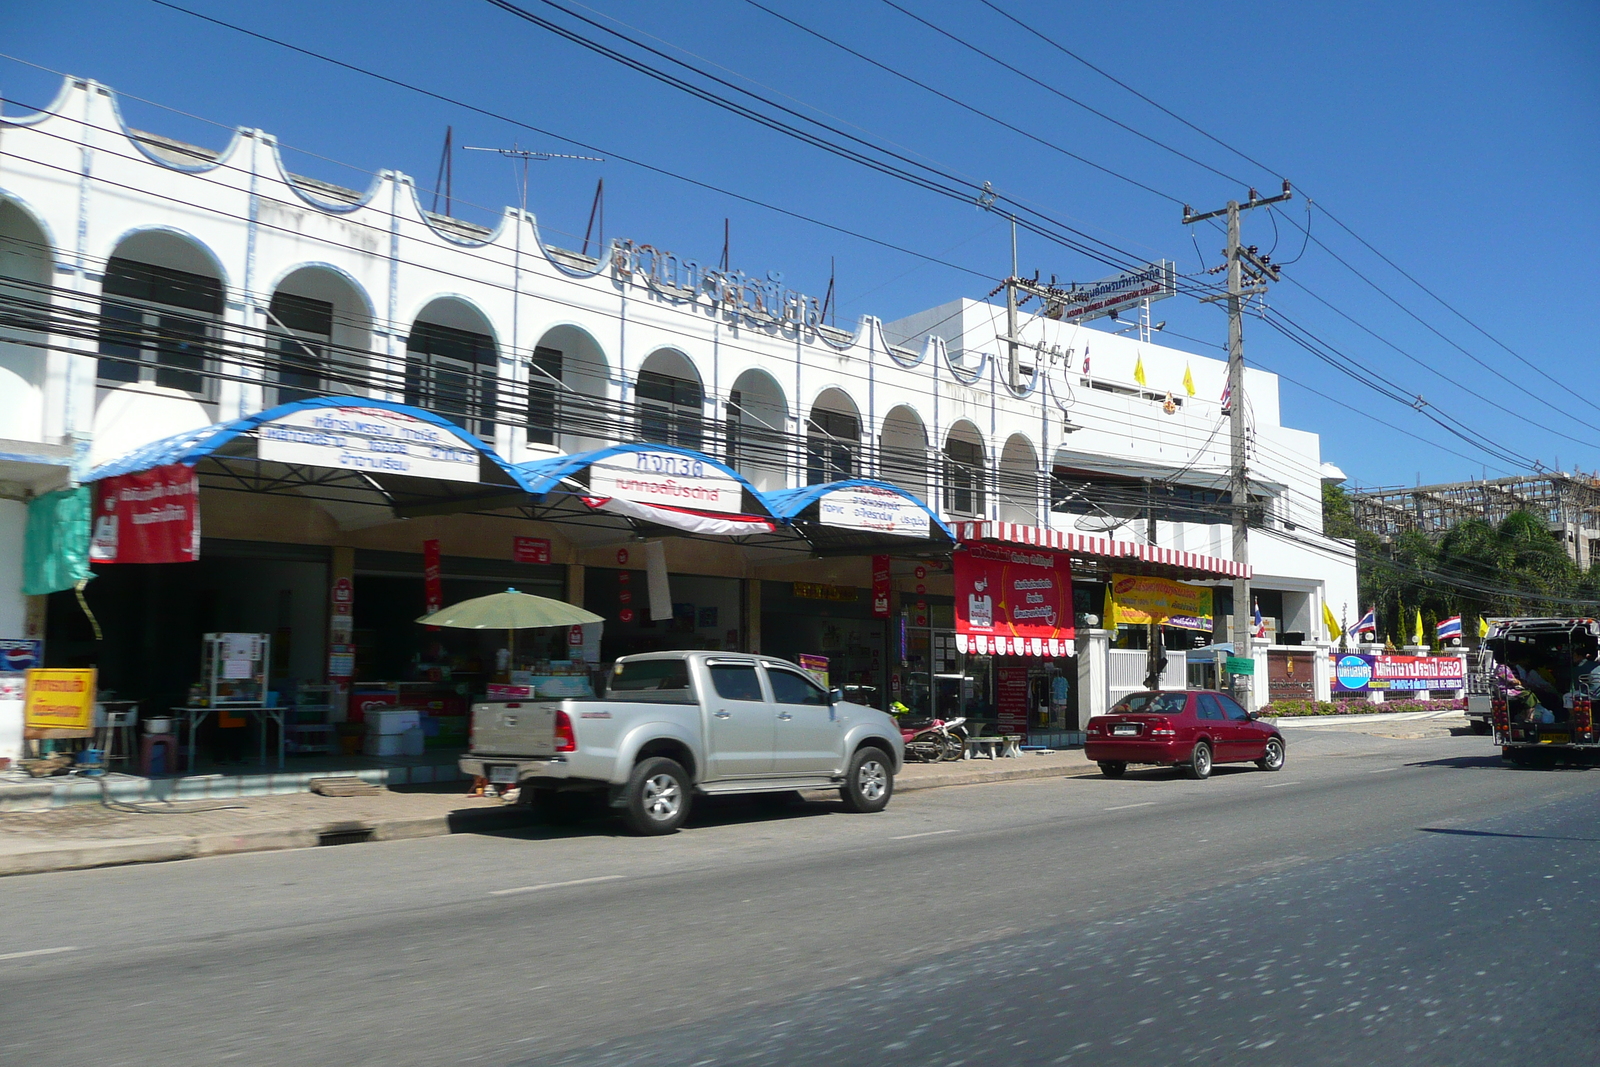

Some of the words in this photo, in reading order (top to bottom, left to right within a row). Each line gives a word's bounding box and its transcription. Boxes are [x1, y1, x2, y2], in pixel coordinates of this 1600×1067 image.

[1104, 291, 1140, 308] ADMINISTRATION
[1140, 284, 1160, 296] COLLEGE
[1439, 660, 1462, 676] 2552
